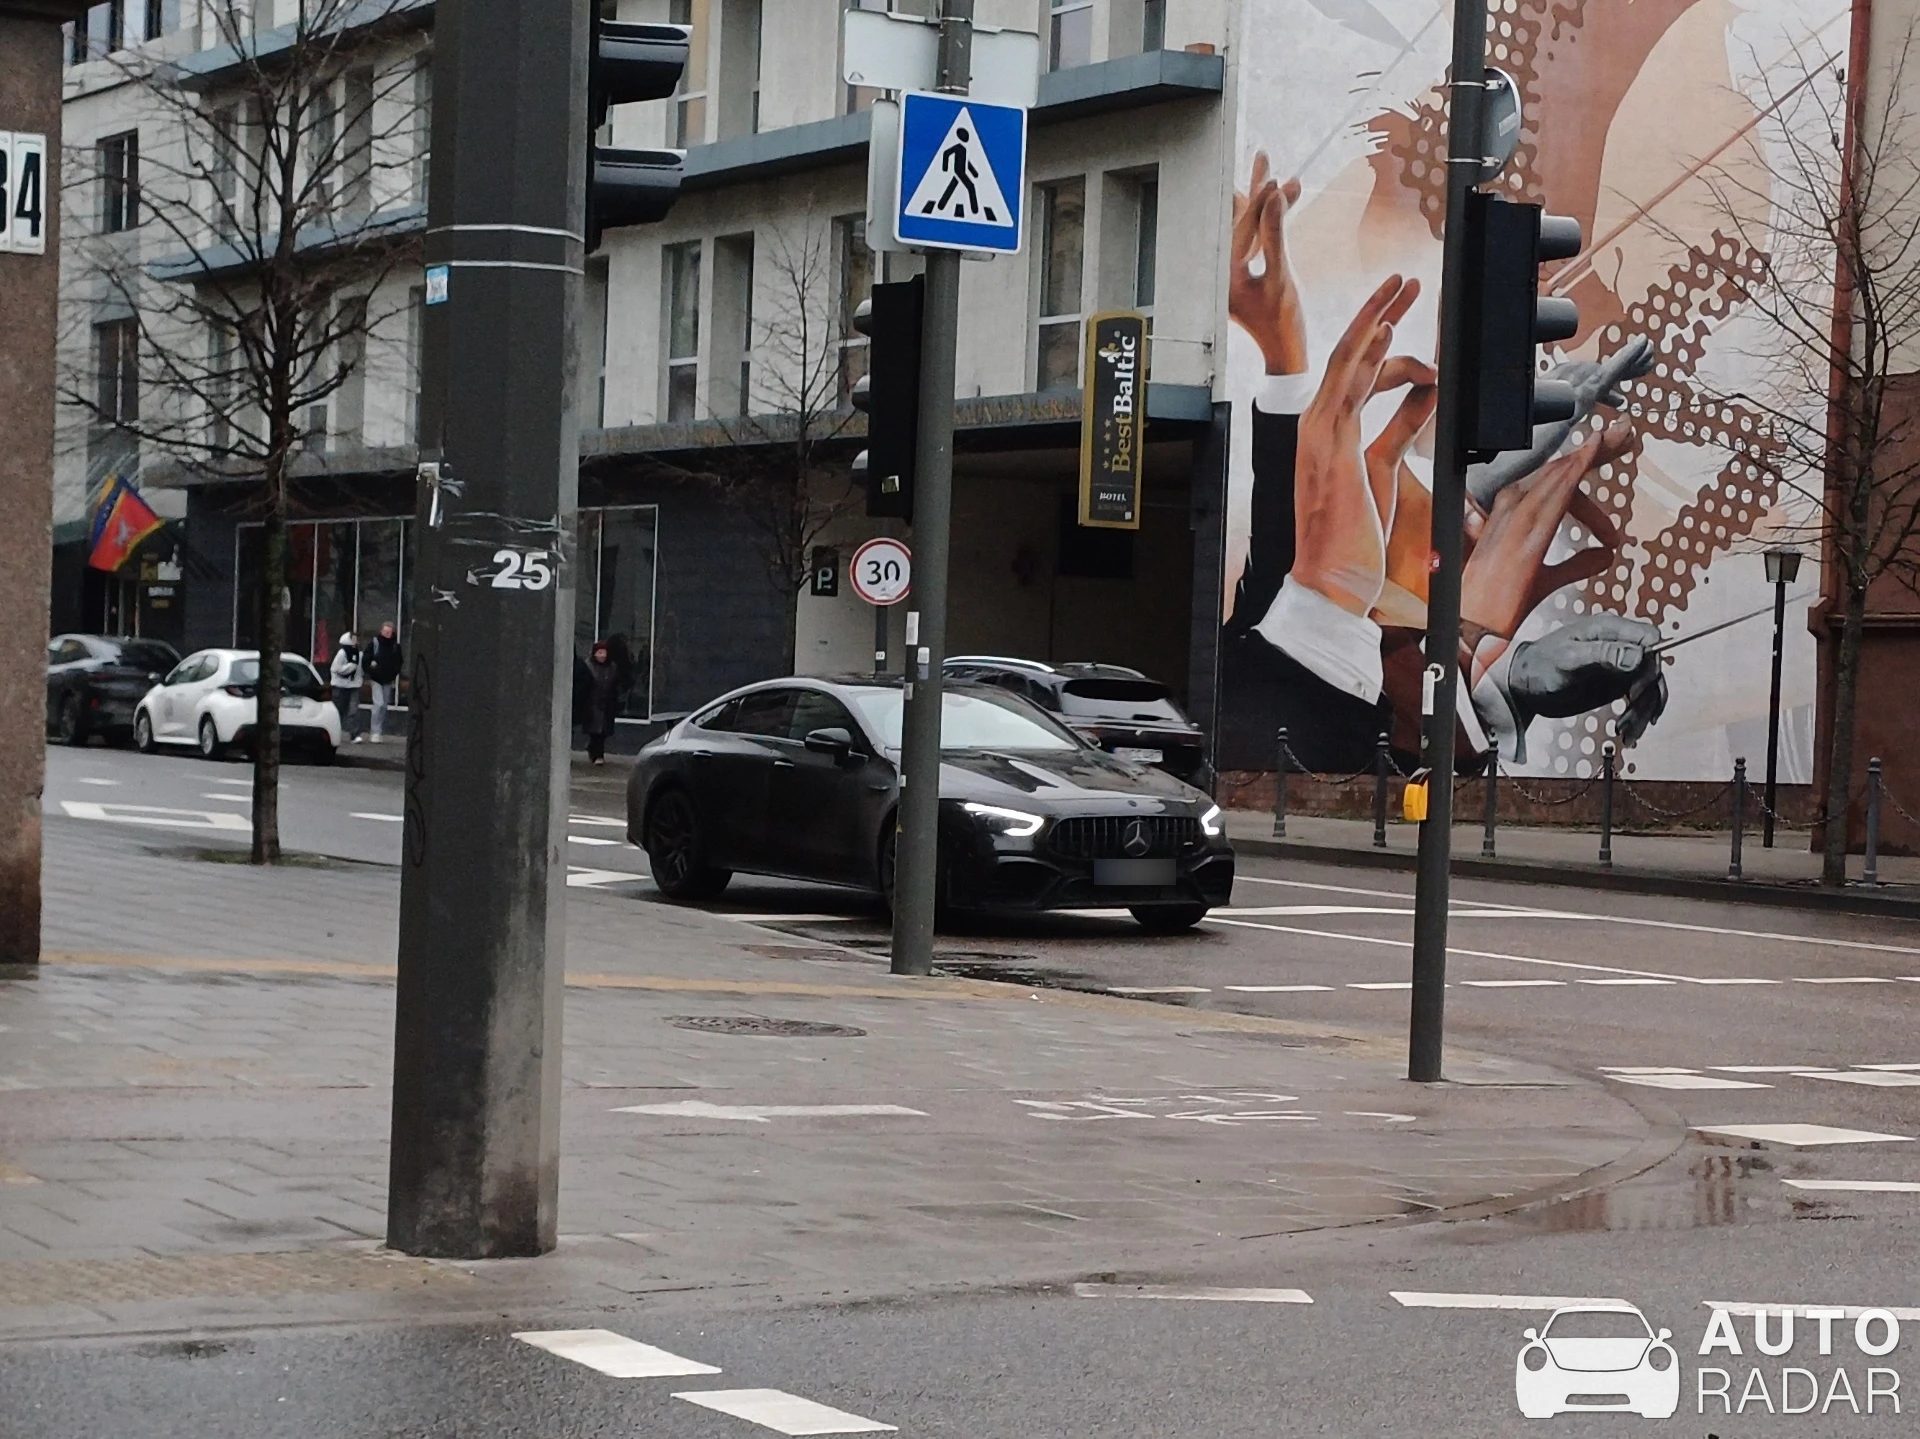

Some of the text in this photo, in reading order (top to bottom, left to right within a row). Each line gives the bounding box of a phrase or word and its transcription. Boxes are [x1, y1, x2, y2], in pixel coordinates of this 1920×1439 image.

[1112, 336, 1136, 473] BestBaltic
[491, 549, 551, 590] 25
[867, 560, 901, 586] 30
